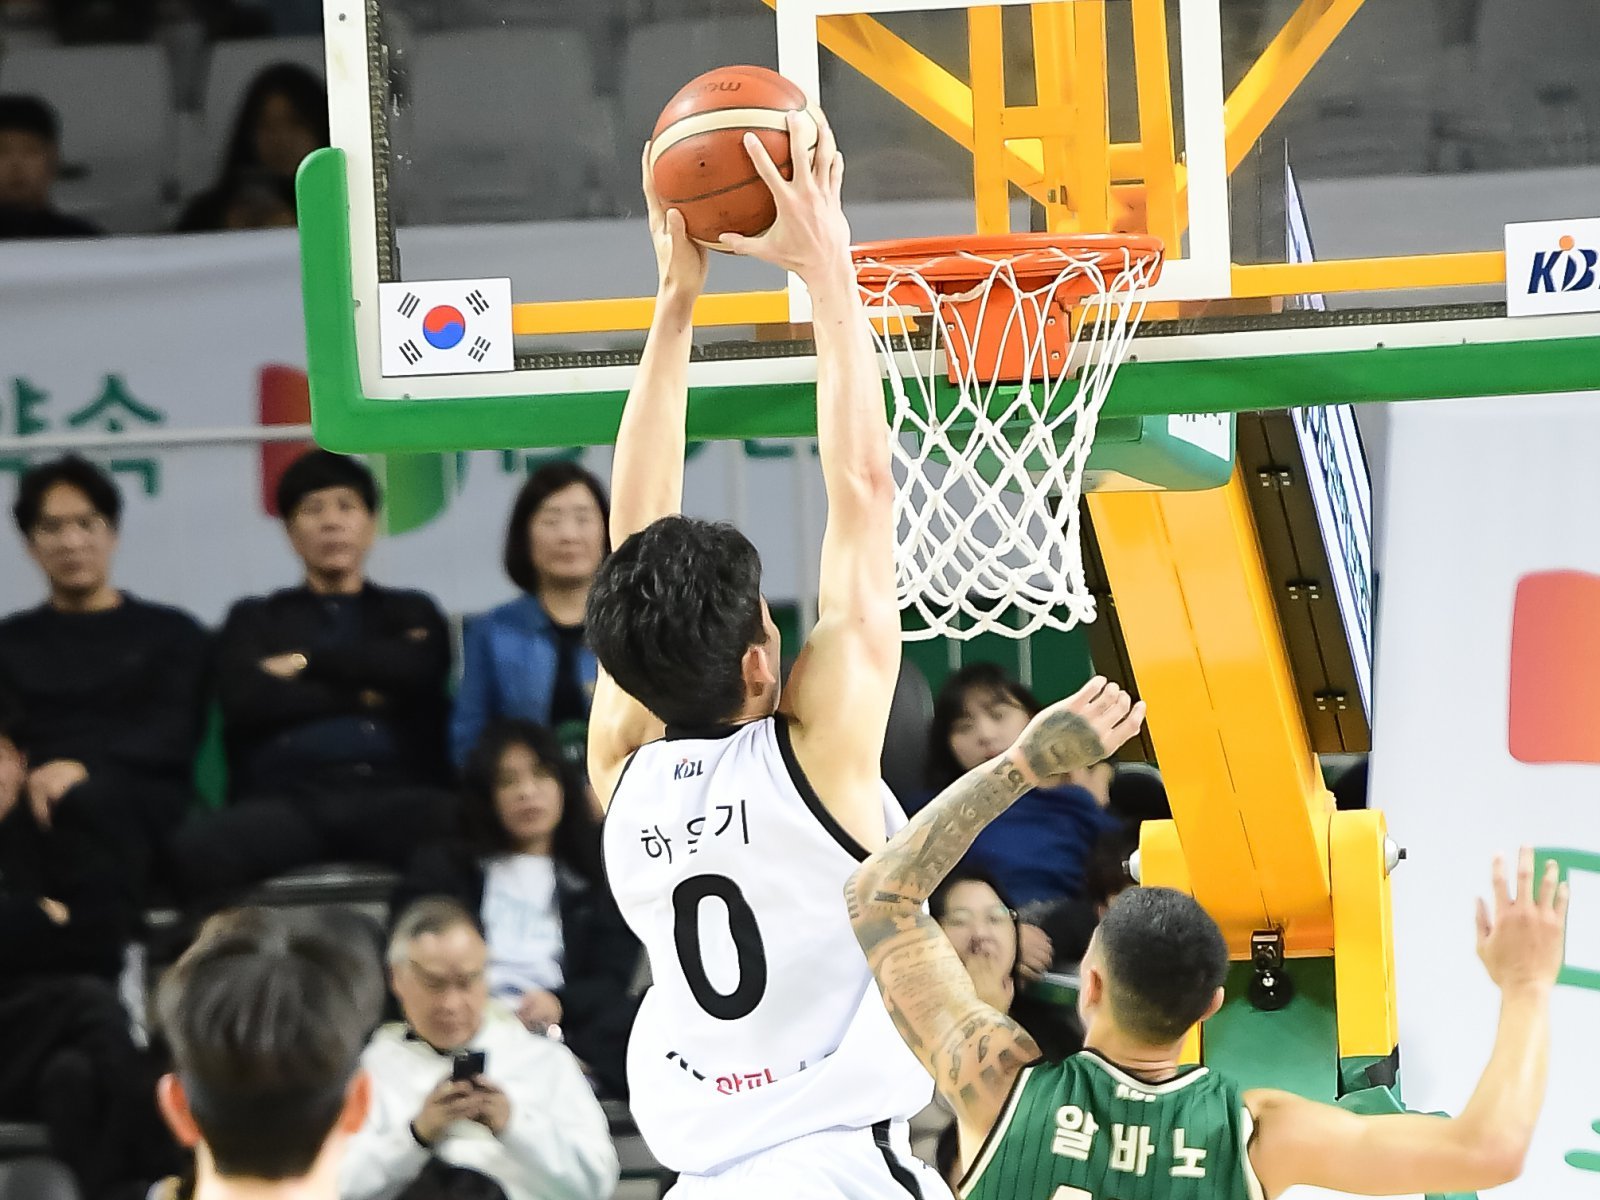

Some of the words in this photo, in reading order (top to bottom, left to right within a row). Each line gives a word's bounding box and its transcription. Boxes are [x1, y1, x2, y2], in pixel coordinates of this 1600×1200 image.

[1526, 234, 1600, 294] KB
[674, 758, 703, 780] KBL
[672, 873, 767, 1020] 0
[1052, 1104, 1208, 1178] 알바노
